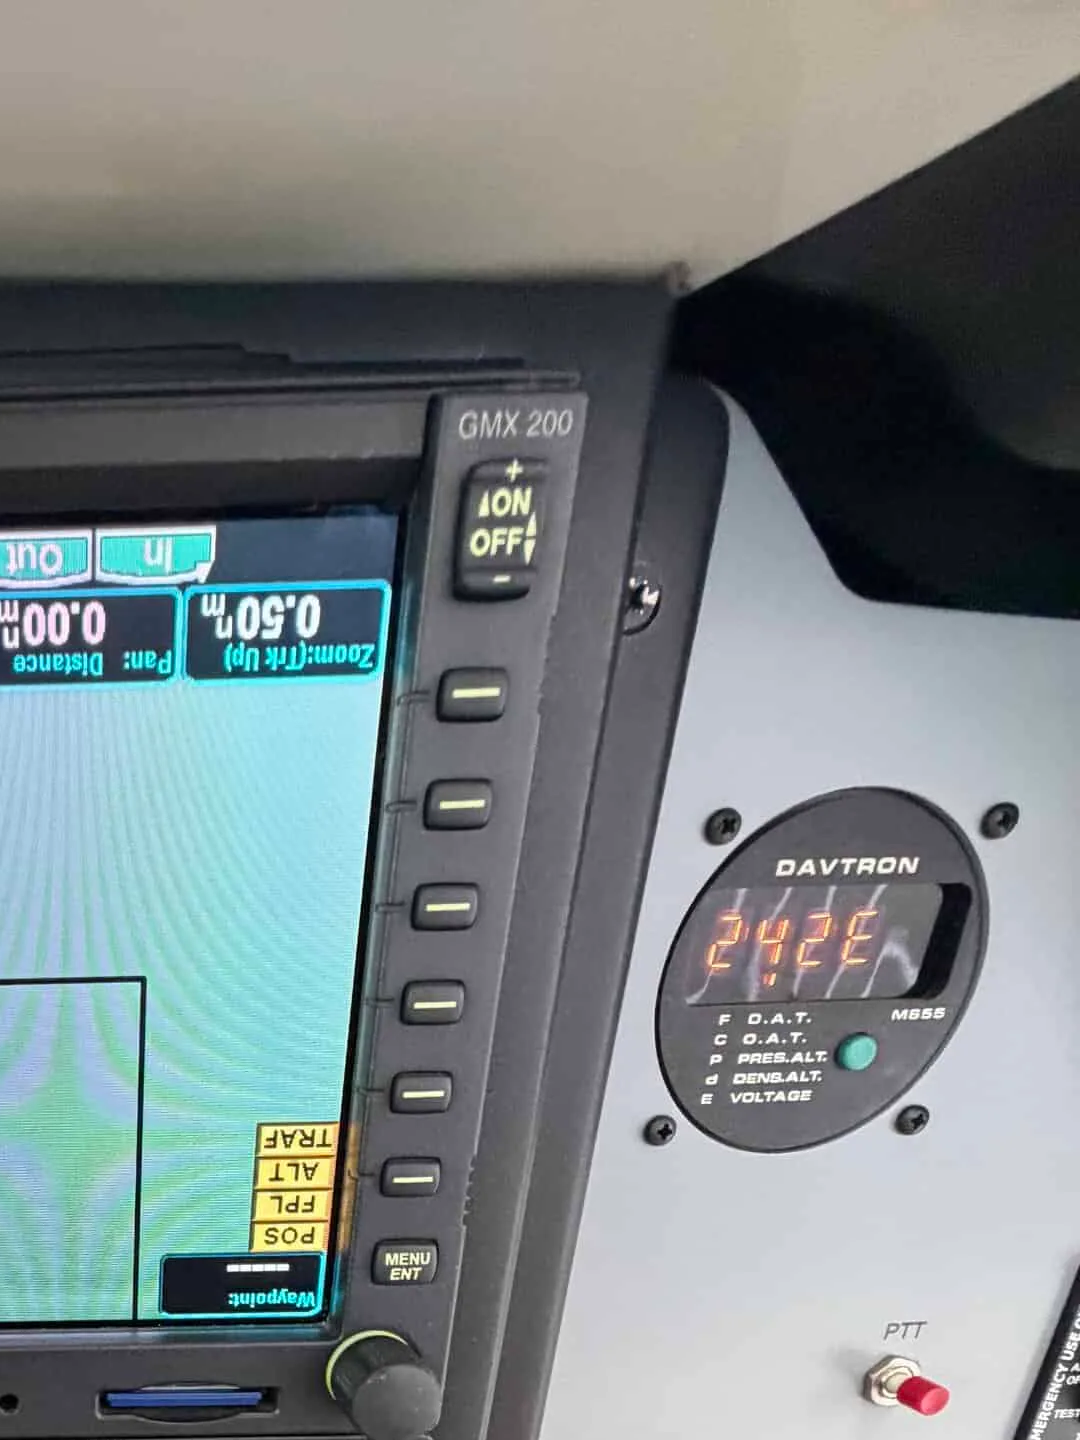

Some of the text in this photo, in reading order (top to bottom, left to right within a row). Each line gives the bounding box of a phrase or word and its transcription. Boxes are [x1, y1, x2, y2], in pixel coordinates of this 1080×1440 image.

[458, 409, 573, 440] GMX 200
[492, 487, 532, 517] ON
[144, 537, 172, 566] In
[470, 527, 524, 557] OFF
[8, 542, 62, 575] Out
[14, 650, 172, 676] Pan: Distance
[775, 857, 920, 877] DAVTRON
[731, 1091, 812, 1104] VOLTAGE
[264, 1129, 332, 1149] TRAF
[269, 1162, 319, 1181] ALT
[270, 1195, 315, 1213] FPL
[265, 1227, 315, 1244] POS
[385, 1252, 431, 1265] MENU
[390, 1268, 422, 1281] ENT
[228, 1289, 315, 1308] Waypoint:
[883, 1321, 927, 1340] PTT
